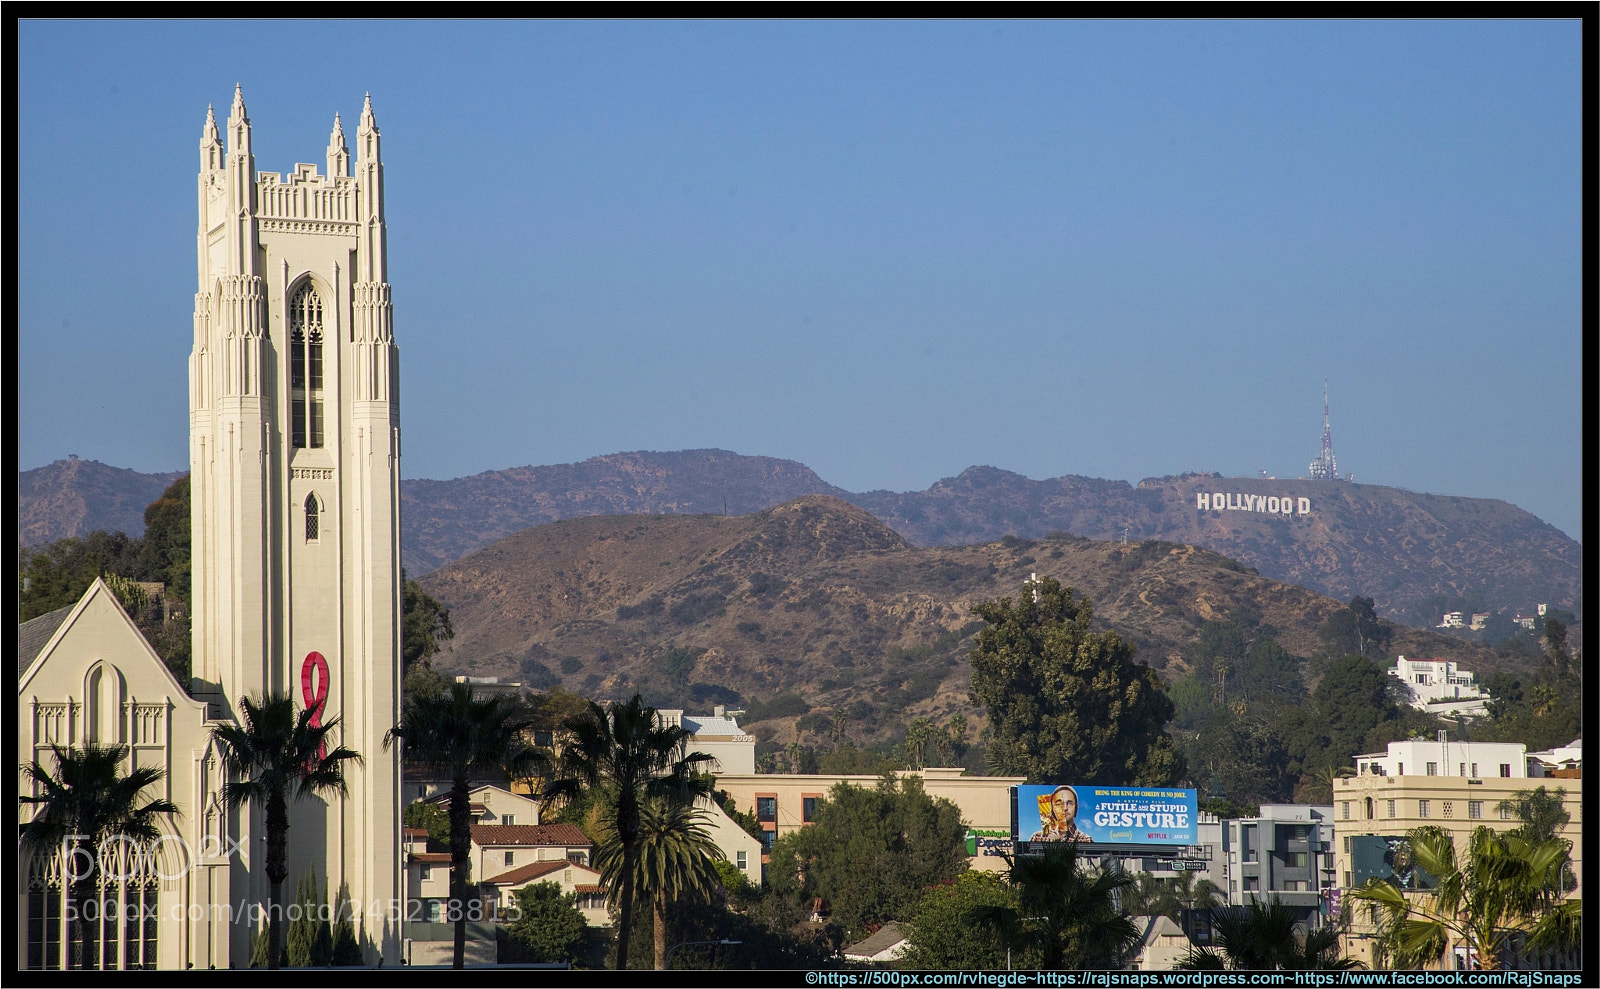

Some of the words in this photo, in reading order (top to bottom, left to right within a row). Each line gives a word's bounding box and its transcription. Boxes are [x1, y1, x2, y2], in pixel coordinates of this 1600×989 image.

[1197, 492, 1311, 516] HOLLYWOOD
[1101, 803, 1137, 811] FUTILE
[1149, 804, 1188, 812] STUPID
[1094, 812, 1189, 828] GESTURE
